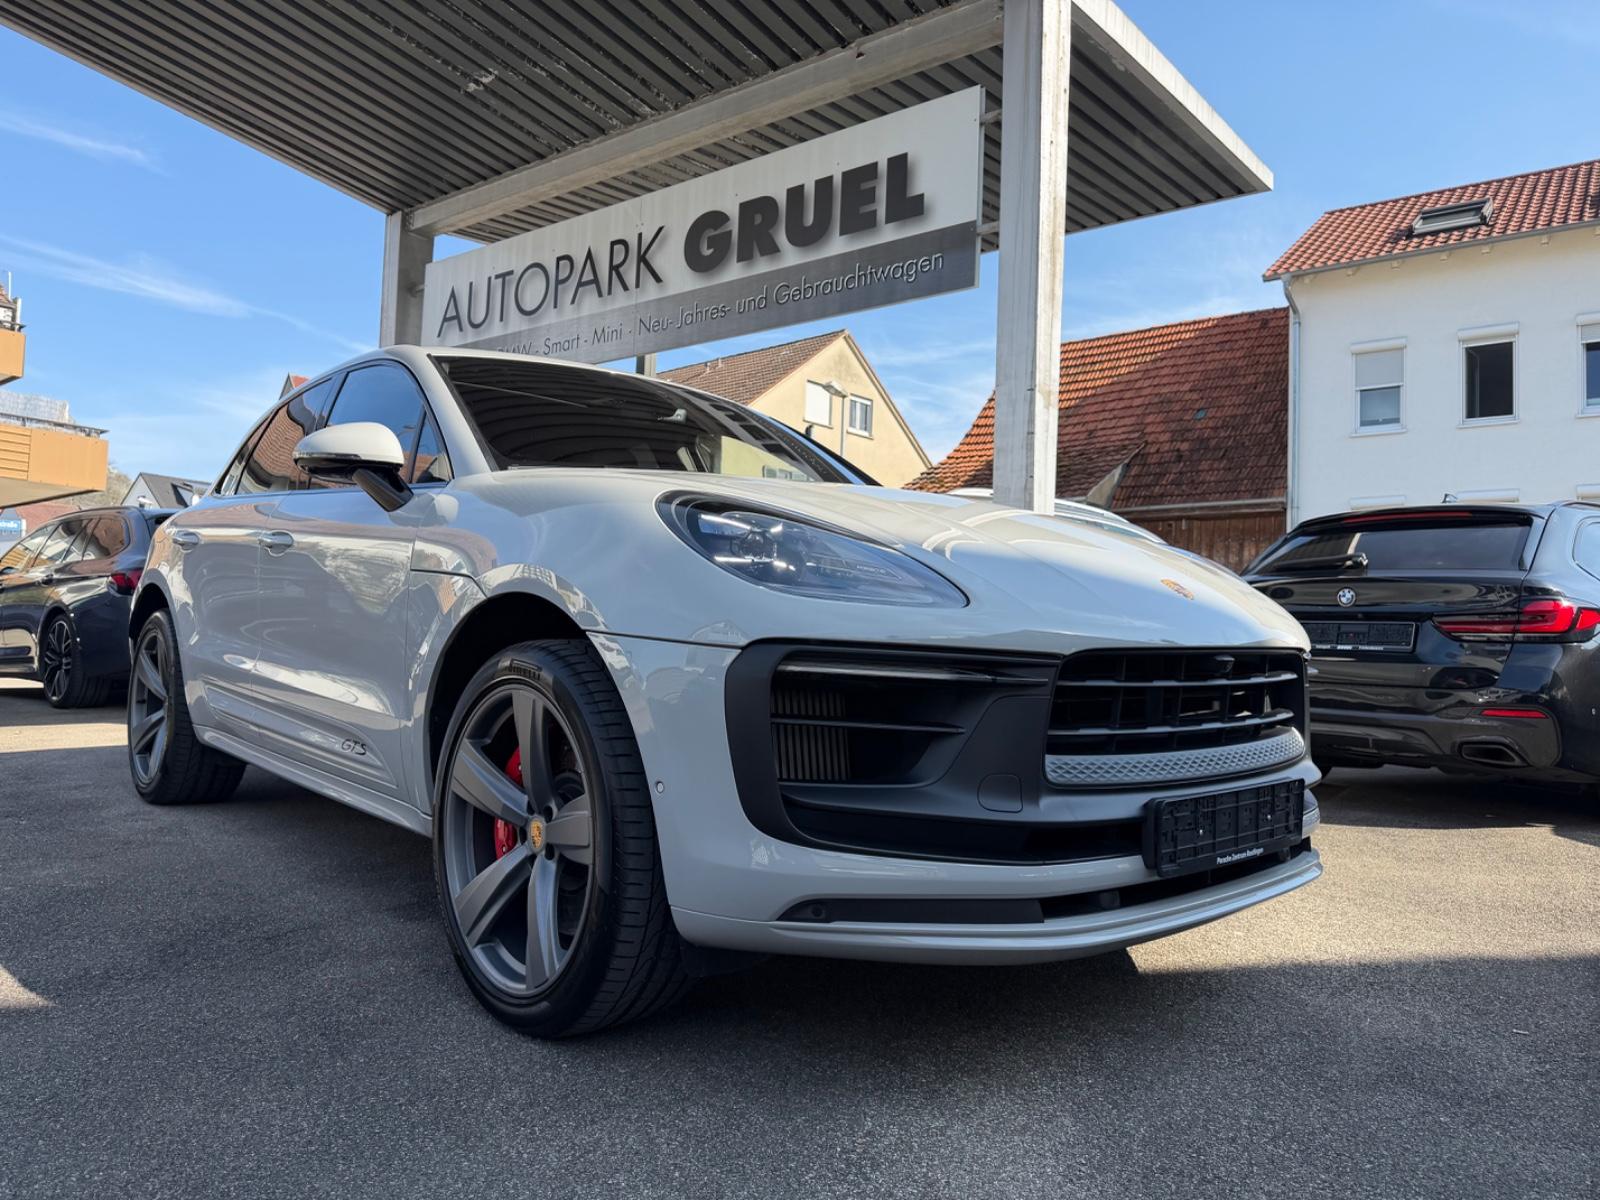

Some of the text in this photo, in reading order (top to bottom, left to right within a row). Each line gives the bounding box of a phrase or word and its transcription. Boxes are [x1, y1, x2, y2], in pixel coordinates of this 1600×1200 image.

[437, 152, 925, 338] AUTOPARK GRUEL
[543, 336, 580, 356] Smart
[591, 322, 623, 346] Mini
[736, 284, 768, 314] und
[773, 252, 945, 305] Gebrauchtwagen
[341, 738, 367, 756] GTS
